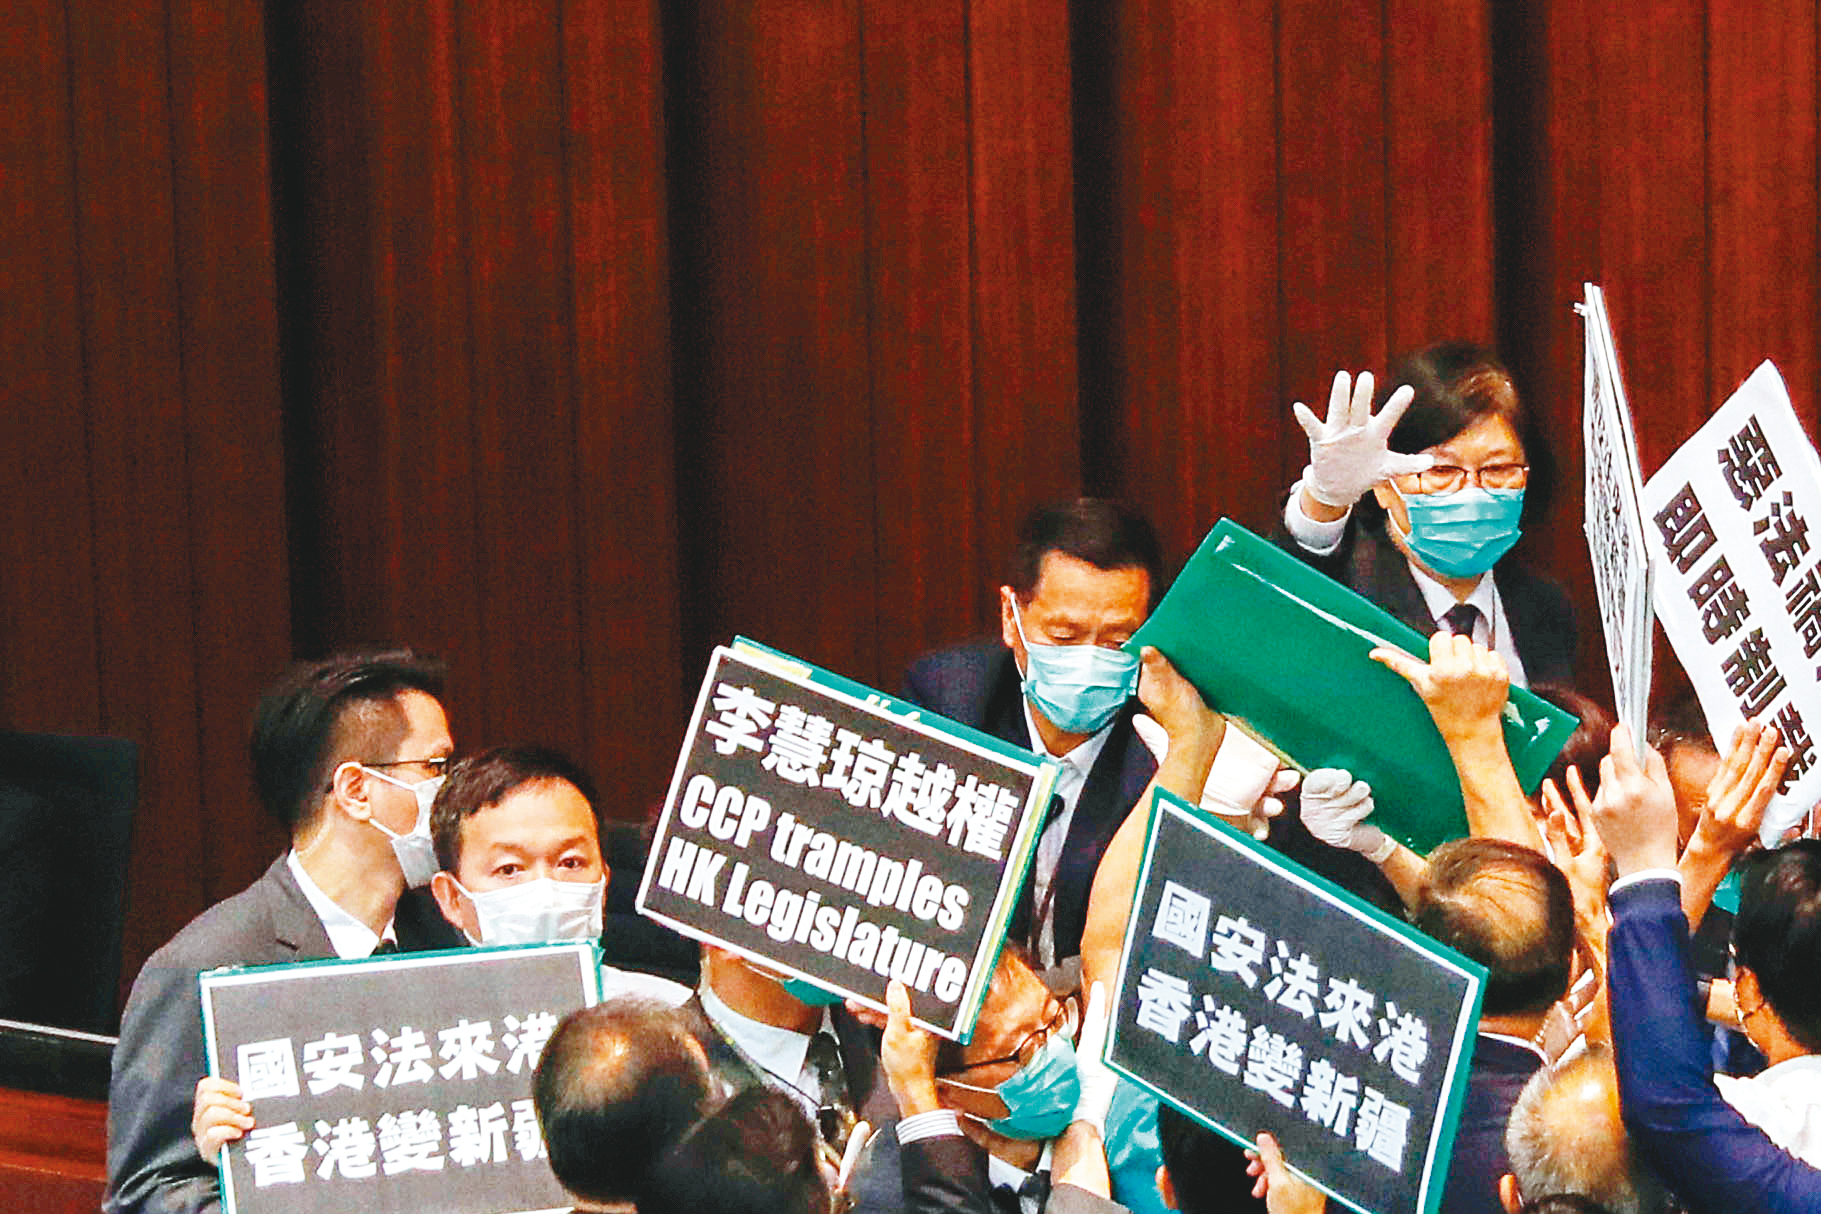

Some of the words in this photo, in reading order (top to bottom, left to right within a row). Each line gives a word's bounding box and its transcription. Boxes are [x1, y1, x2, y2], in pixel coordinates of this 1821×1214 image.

[679, 774, 772, 848] CCP
[771, 811, 970, 931] tramples
[705, 682, 1019, 861] 李慧琼越權
[658, 835, 728, 907] HK
[722, 861, 968, 1003] Legislature
[1152, 879, 1429, 1085] 國安法來港
[1136, 968, 1412, 1173] 香港變新疆
